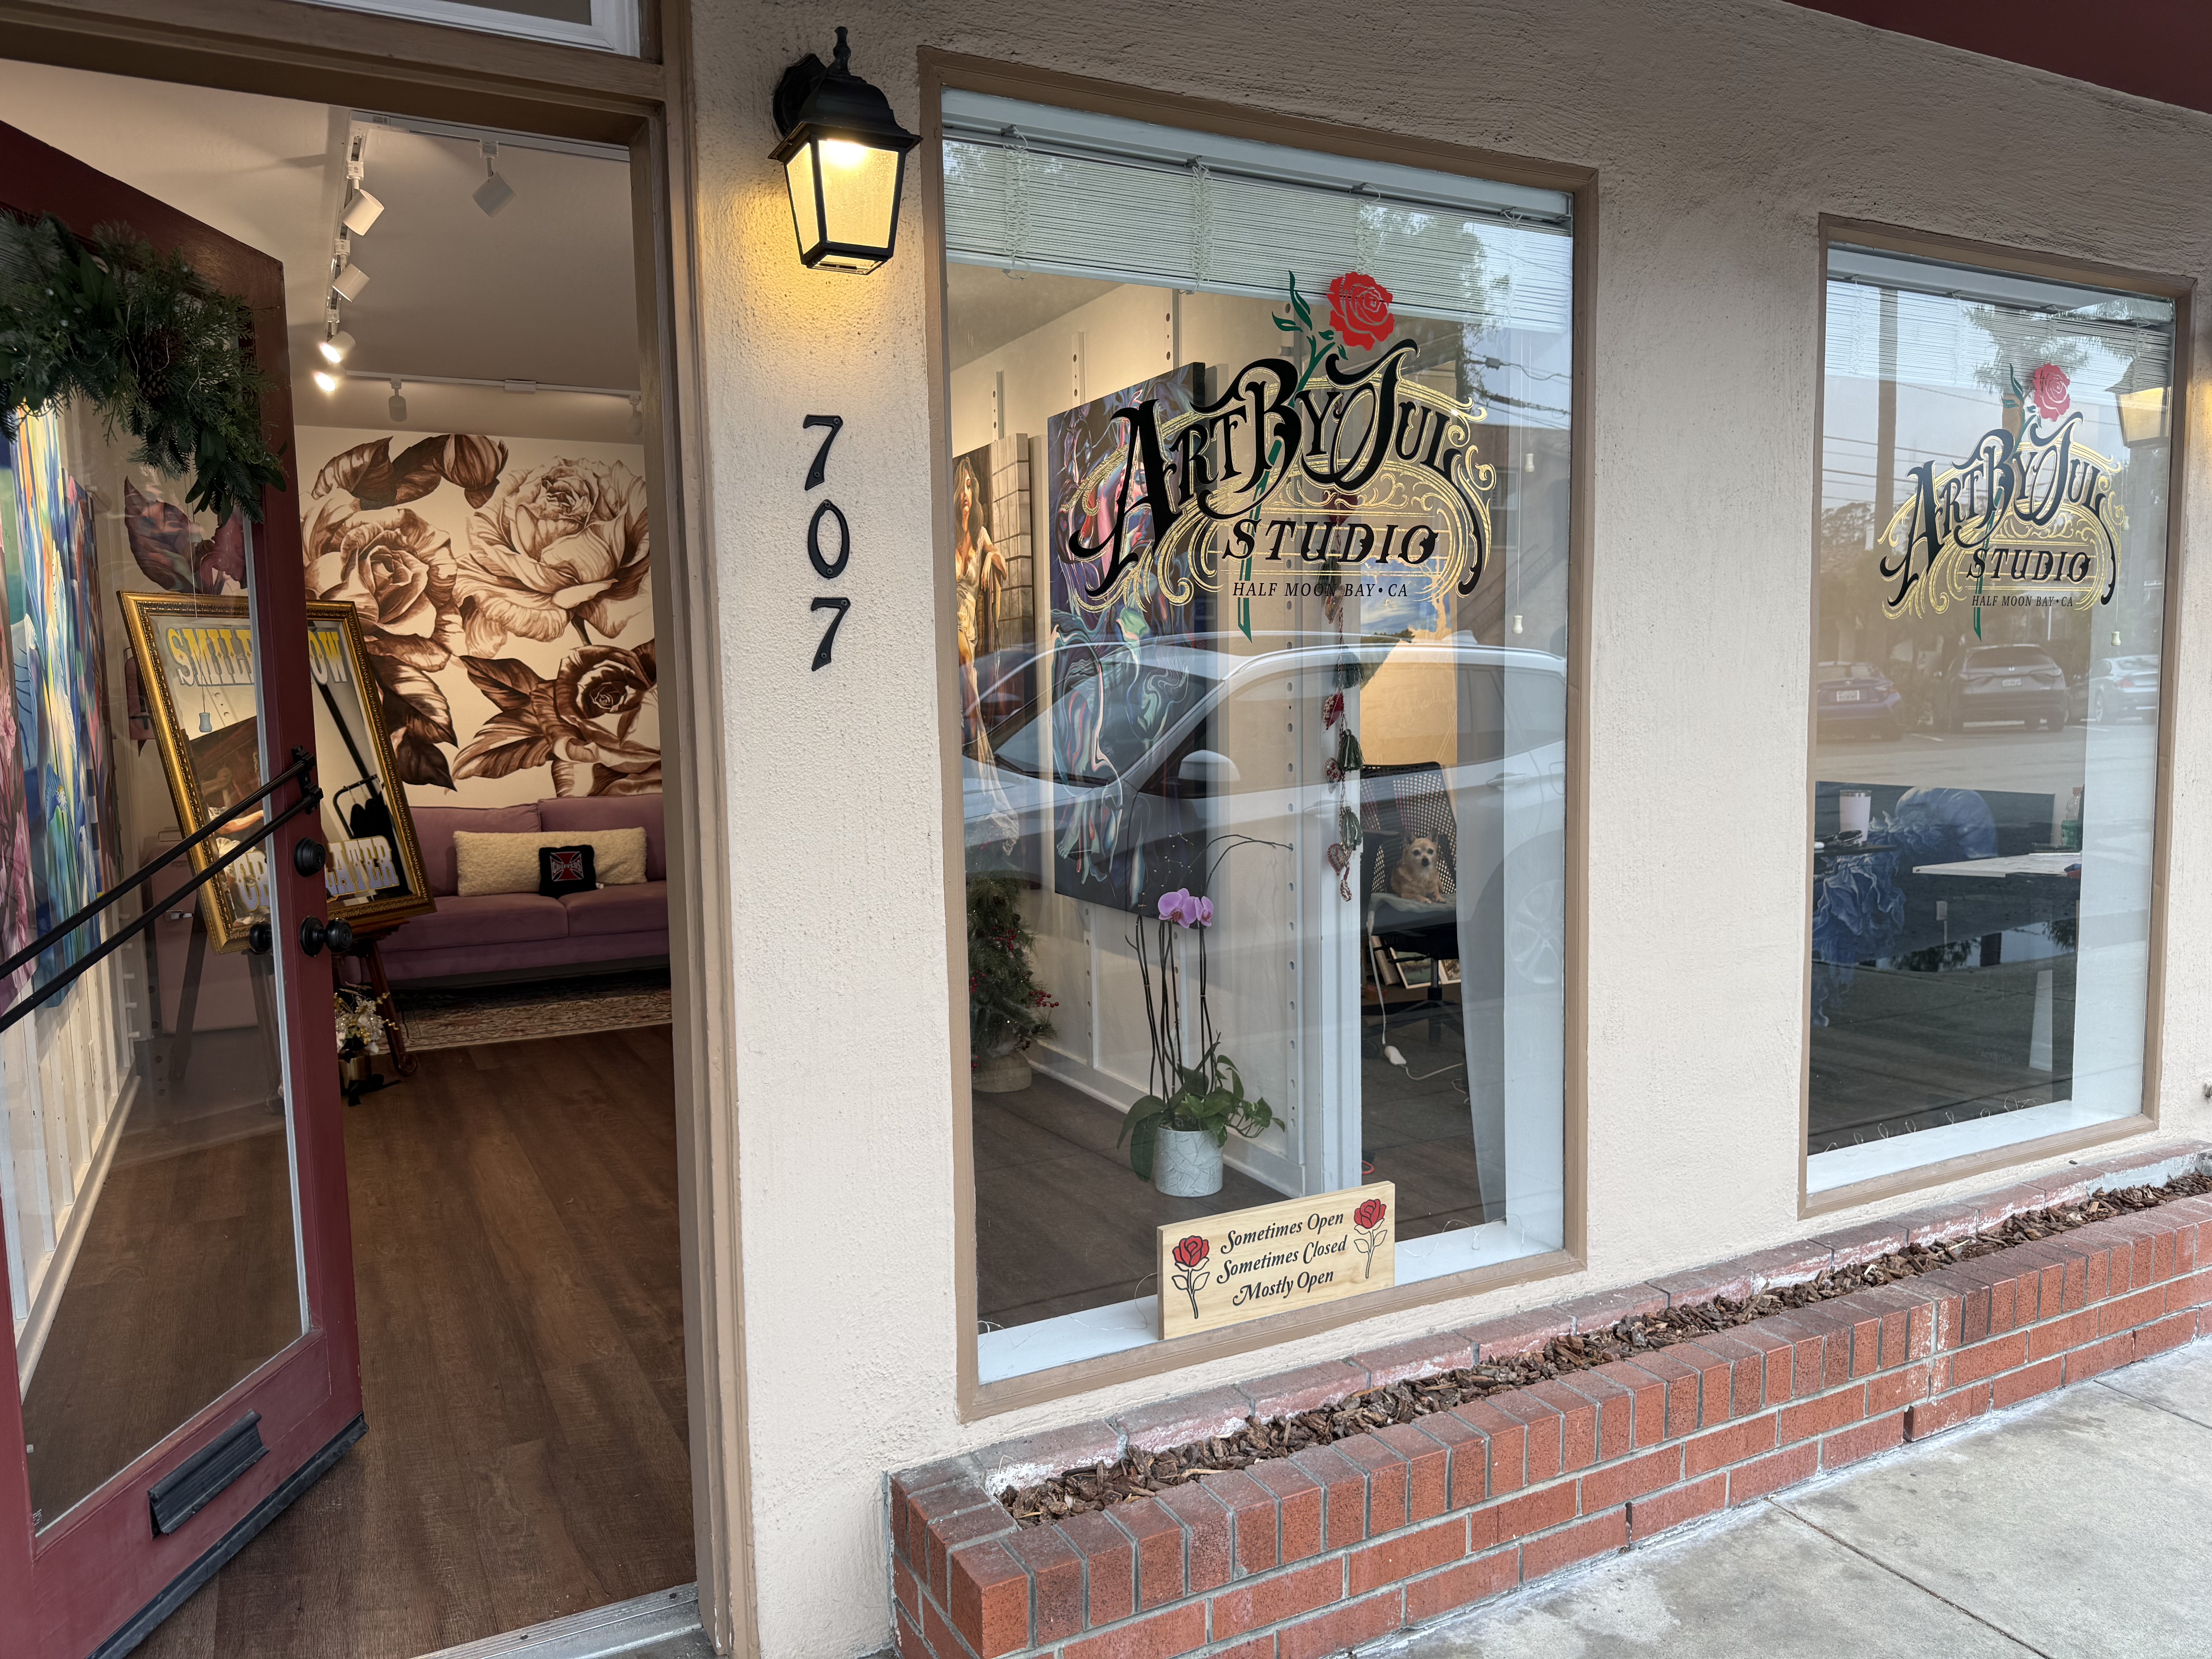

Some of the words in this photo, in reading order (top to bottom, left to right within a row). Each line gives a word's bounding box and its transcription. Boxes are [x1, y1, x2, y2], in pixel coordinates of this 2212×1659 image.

[803, 414, 850, 672] 707
[1222, 519, 1438, 564] STUDIO
[1966, 548, 2091, 582] STUDIO
[1233, 582, 1278, 596] HALF
[1284, 582, 1337, 596] MOON
[1972, 595, 1998, 606] HALF
[2001, 596, 2032, 606] MOON
[308, 630, 347, 685] OW
[233, 850, 270, 912] CR
[552, 859, 582, 873] CHOPPERS
[1220, 1221, 1302, 1254] Sometimes
[1307, 1212, 1344, 1235] Open
[1216, 1251, 1299, 1284] Sometimes
[1303, 1235, 1348, 1264] Closed
[1232, 1275, 1293, 1306] Mostly
[1297, 1269, 1334, 1293] Open
